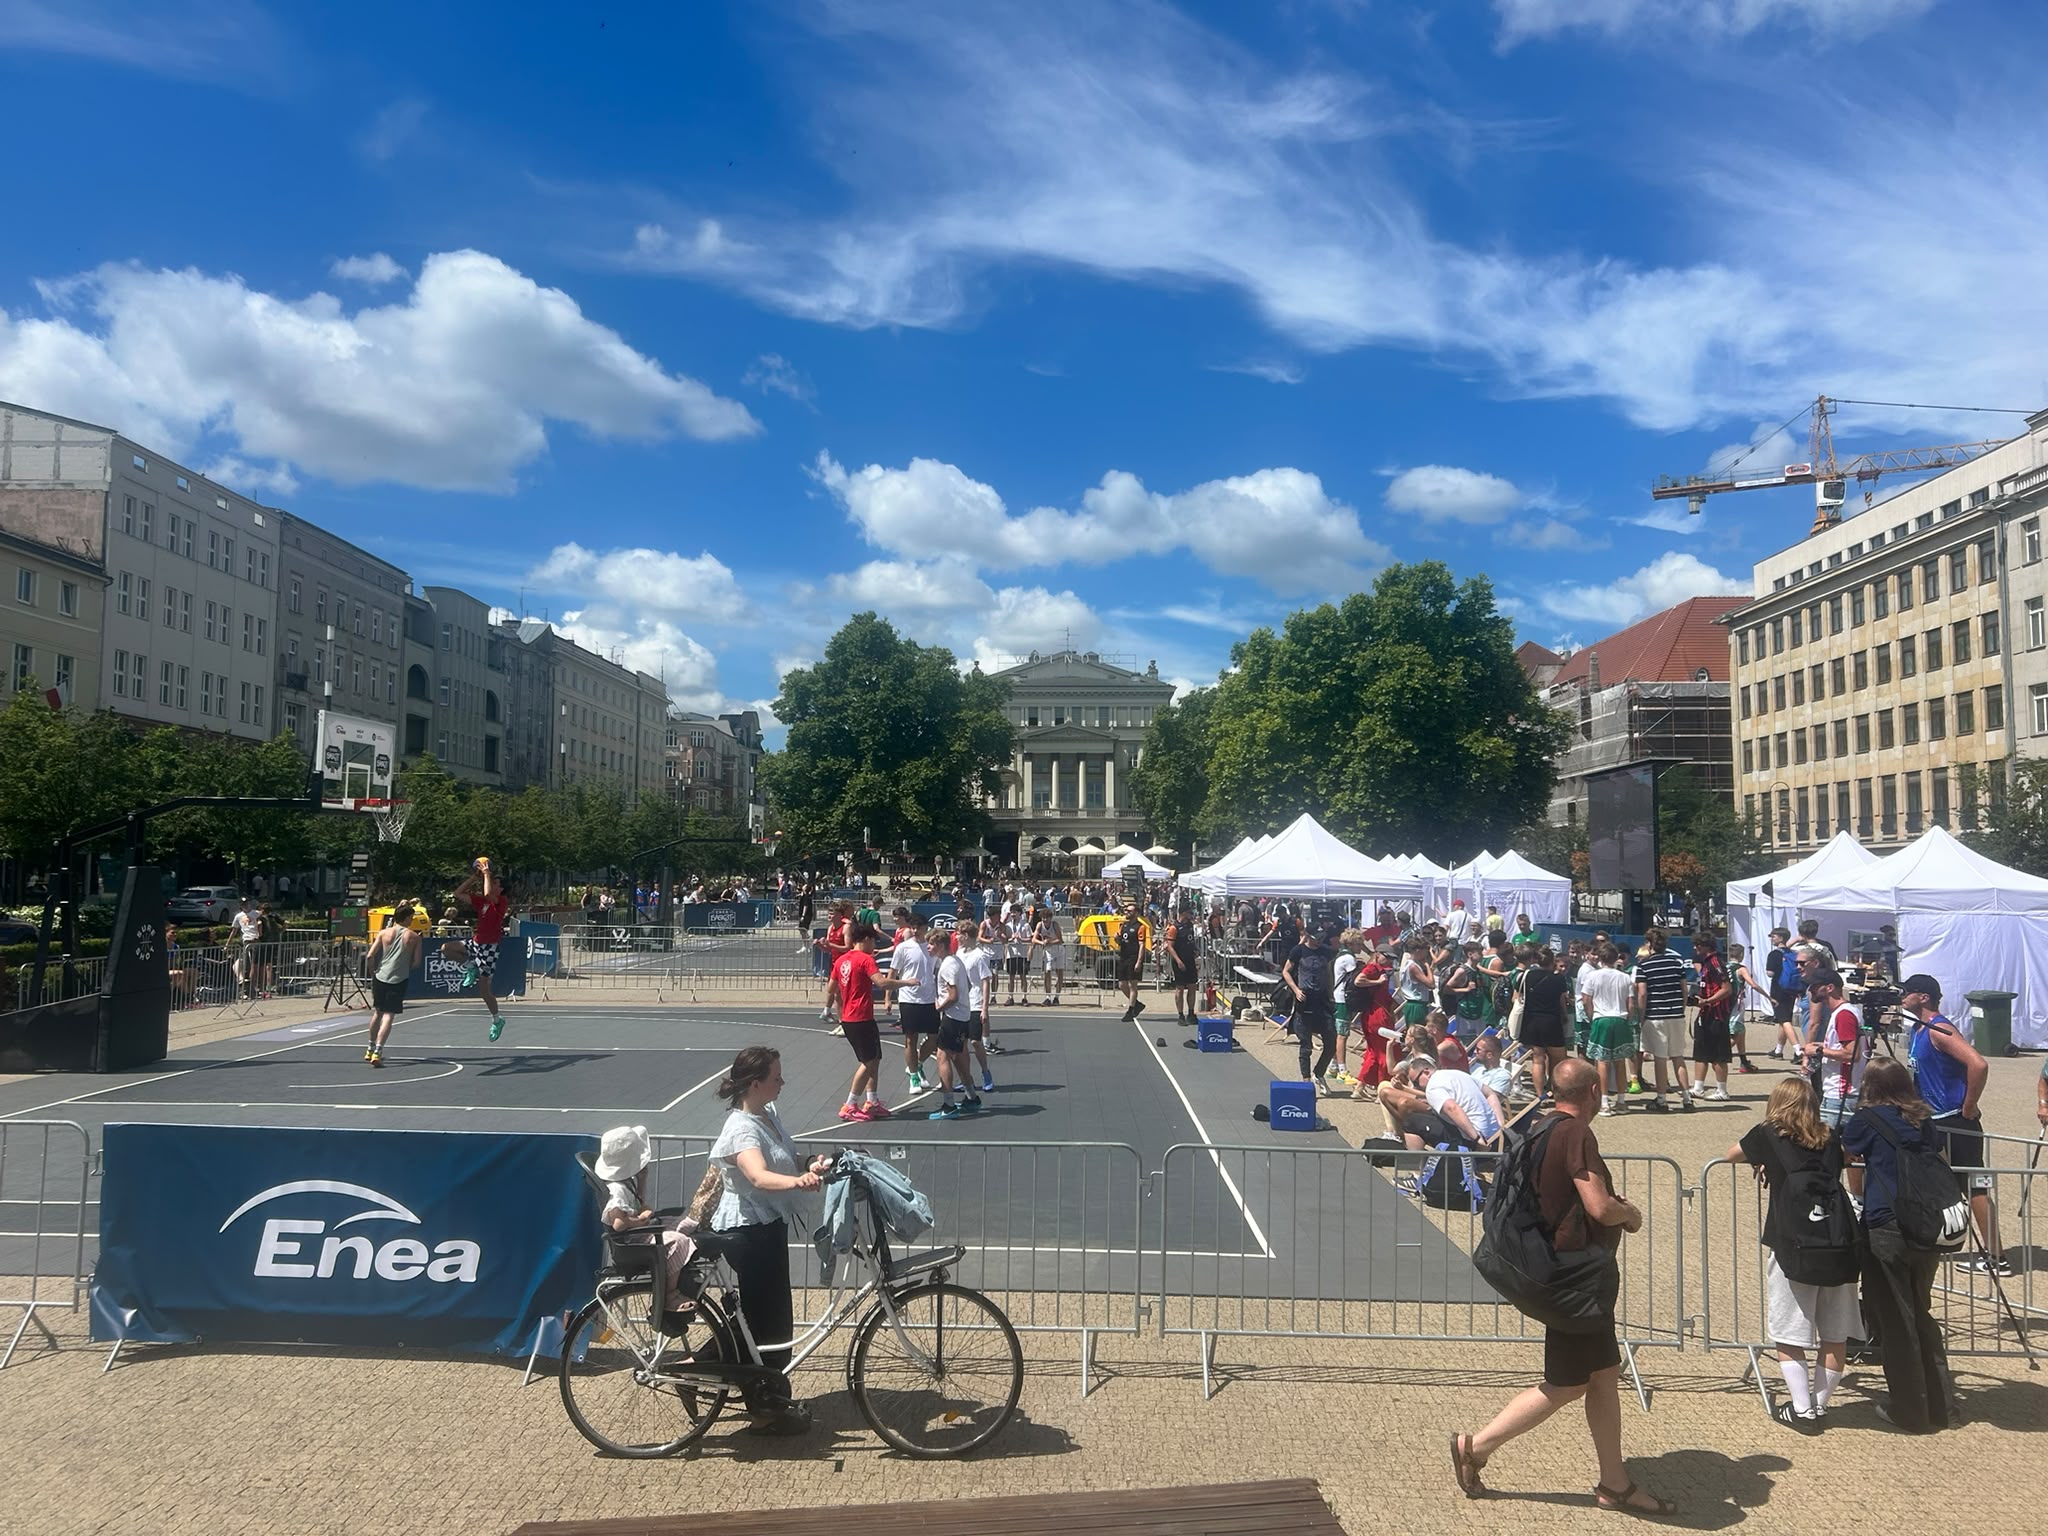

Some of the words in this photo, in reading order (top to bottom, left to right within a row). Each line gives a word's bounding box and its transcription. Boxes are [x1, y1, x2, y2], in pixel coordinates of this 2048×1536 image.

[933, 919, 958, 929] Ene
[135, 945, 155, 961] SHOT
[429, 959, 468, 974] BASK
[1281, 1109, 1309, 1119] Enea
[253, 1218, 482, 1284] Enea
